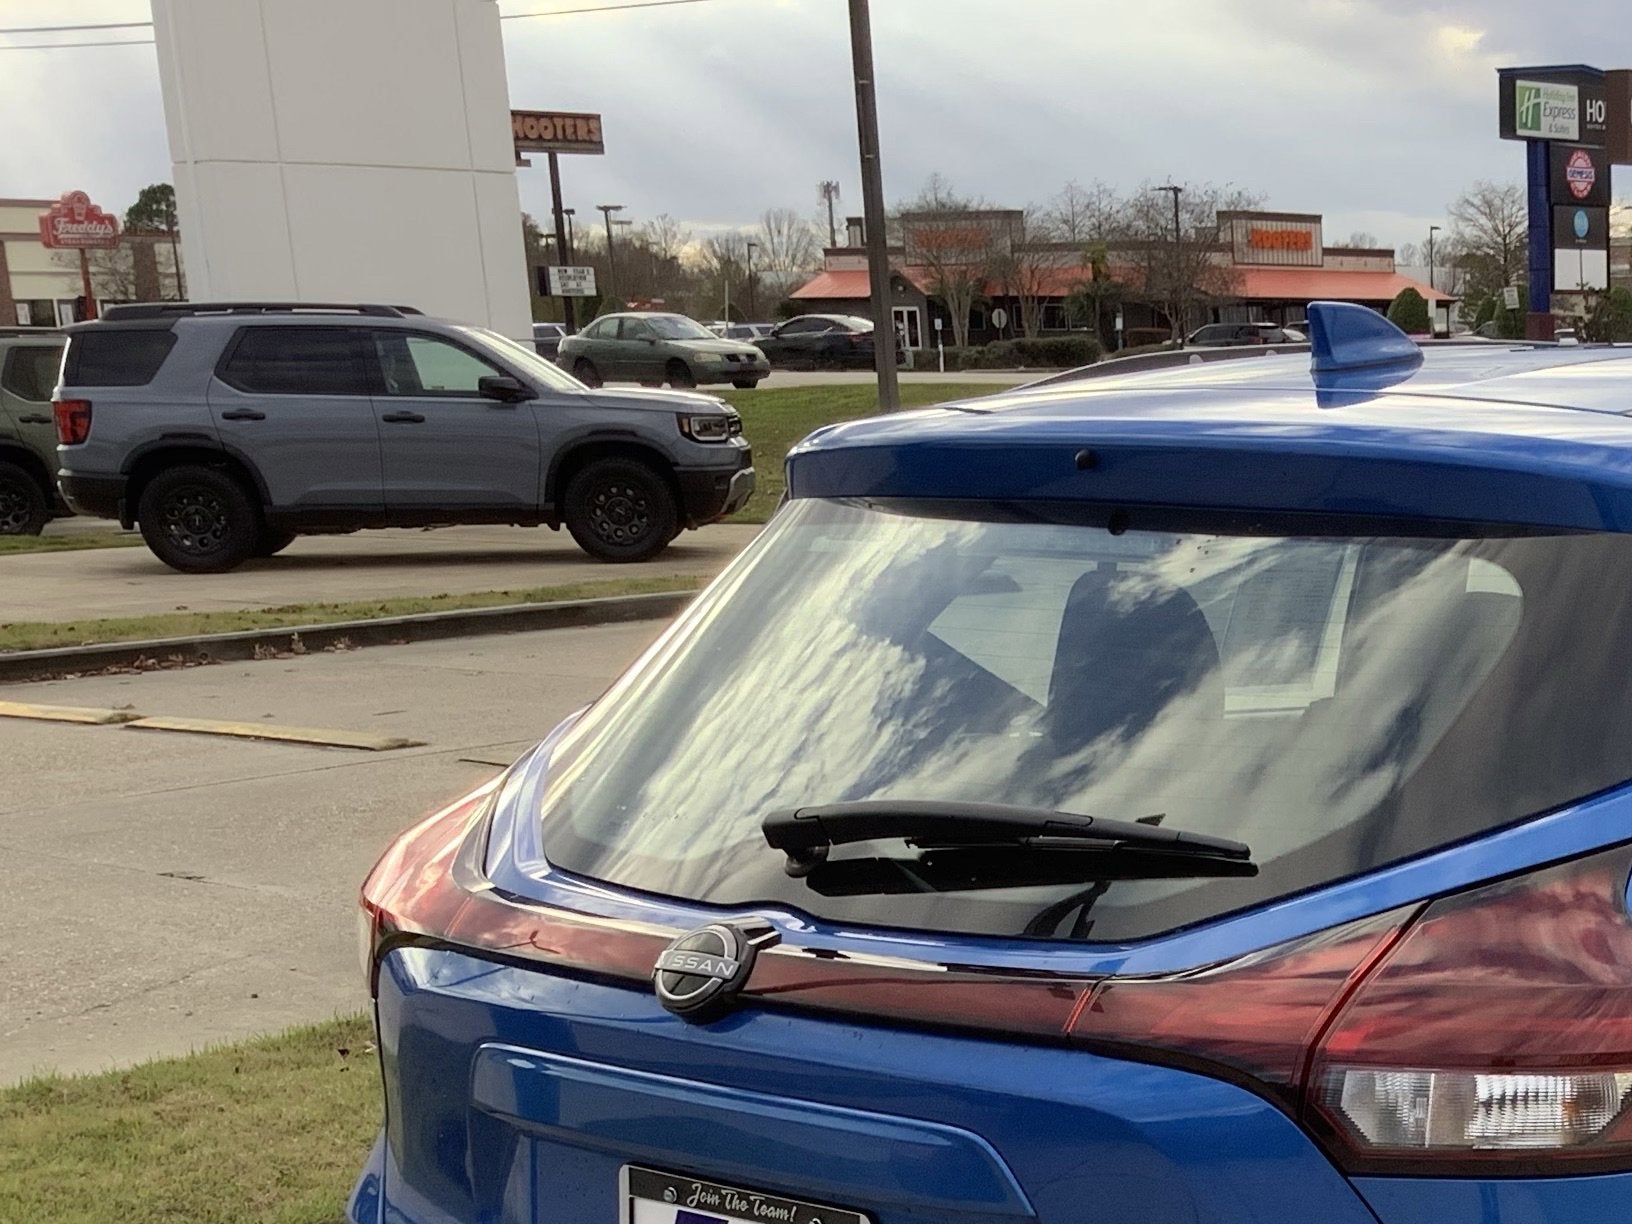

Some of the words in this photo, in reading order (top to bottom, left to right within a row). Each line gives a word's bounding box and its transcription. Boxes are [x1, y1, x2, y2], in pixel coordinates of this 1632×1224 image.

[1543, 101, 1577, 121] Express
[1586, 99, 1606, 123] HO
[511, 115, 600, 141] HOOTERS
[664, 954, 734, 977] ISSAN
[686, 1183, 721, 1207] Join
[721, 1188, 749, 1211] The
[749, 1195, 797, 1222] Team!
